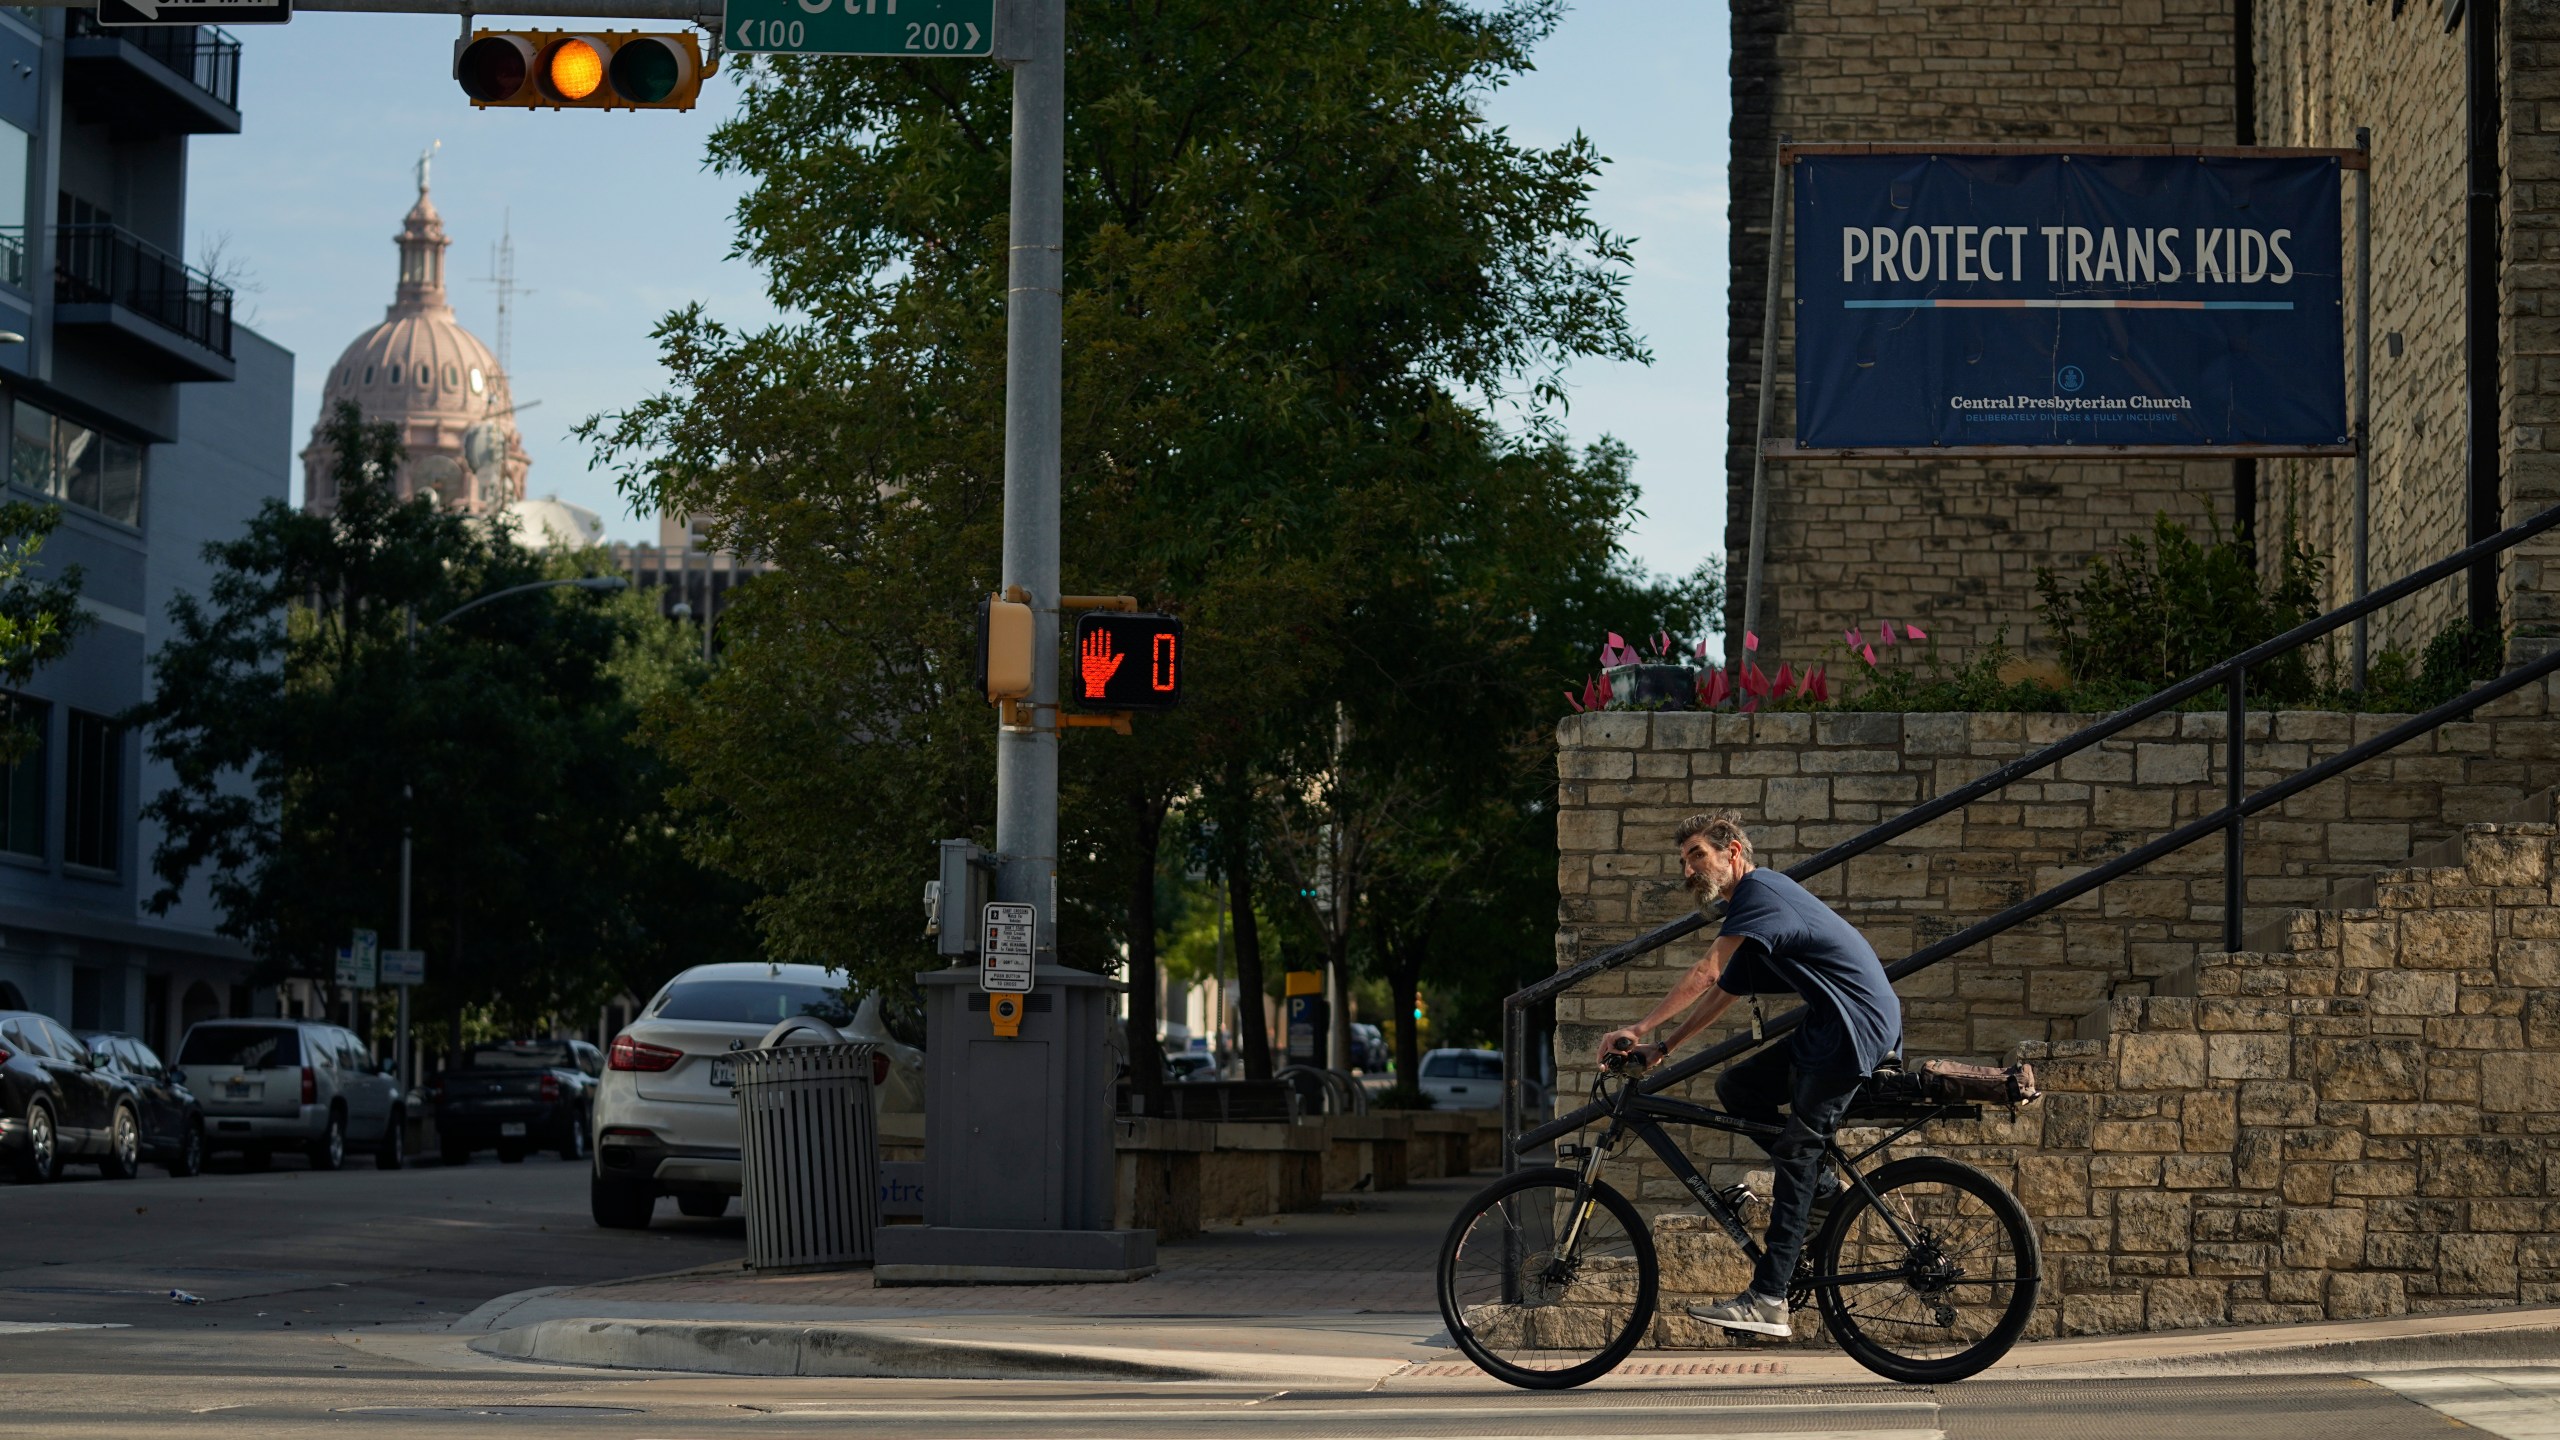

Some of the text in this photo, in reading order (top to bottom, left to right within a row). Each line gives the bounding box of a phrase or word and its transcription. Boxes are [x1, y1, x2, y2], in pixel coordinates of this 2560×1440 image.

[759, 20, 960, 50] 100 200
[1843, 225, 2294, 284] PROTECT TRANS KIDS
[1950, 395, 2192, 412] Central Presbyterian Church
[1966, 413, 2037, 422] DELIBERATELY
[2040, 413, 2081, 422] DIVERSE
[2094, 413, 2123, 422] FULLY
[2126, 413, 2178, 422] INCLUSIVE
[1153, 633, 1175, 690] 0
[1292, 999, 1305, 1018] P
